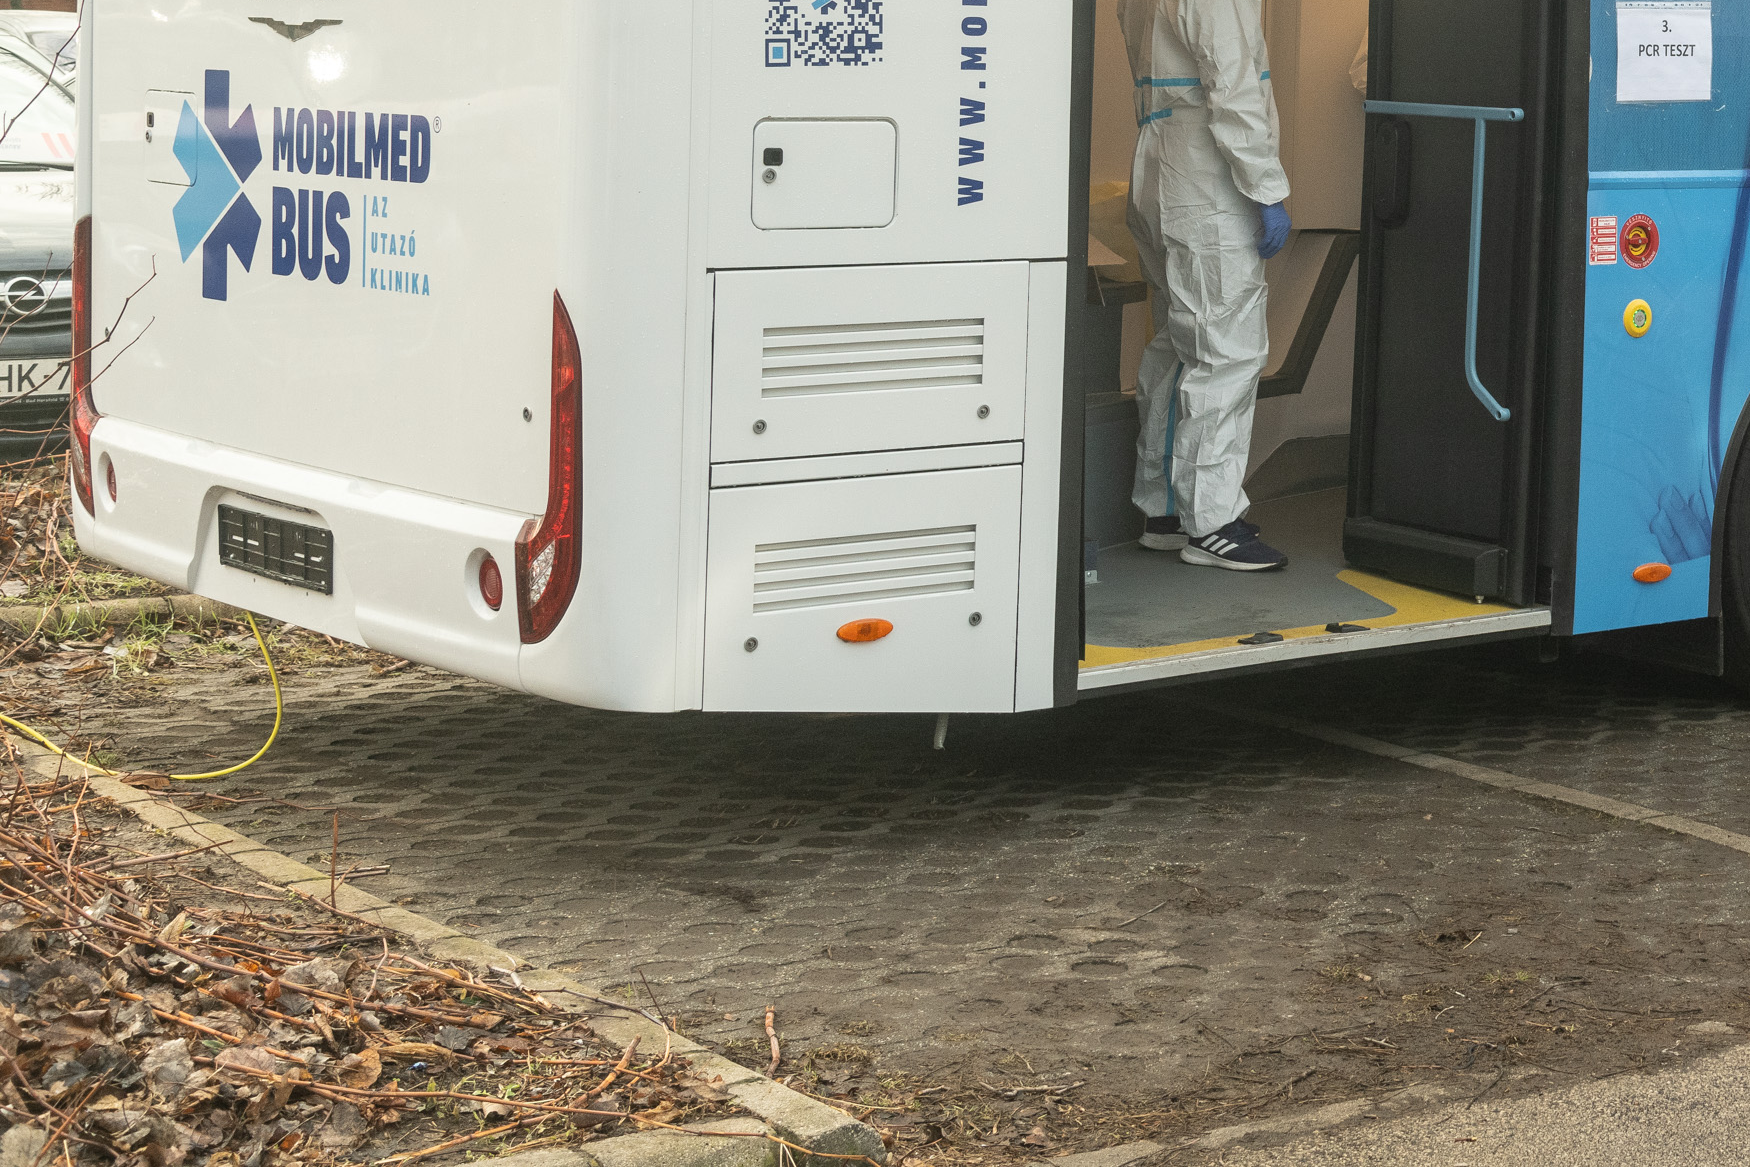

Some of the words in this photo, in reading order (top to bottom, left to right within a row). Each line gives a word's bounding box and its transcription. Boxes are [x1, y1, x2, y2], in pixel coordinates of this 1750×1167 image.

[1662, 20, 1672, 33] 3.
[1638, 44, 1660, 57] PCR
[1663, 44, 1696, 57] TESZT
[273, 106, 432, 184] MOBILMED
[371, 195, 388, 219] AZ
[272, 185, 351, 285] BUS
[371, 229, 416, 258] UTAZÓ
[370, 267, 431, 296] KLINIKA
